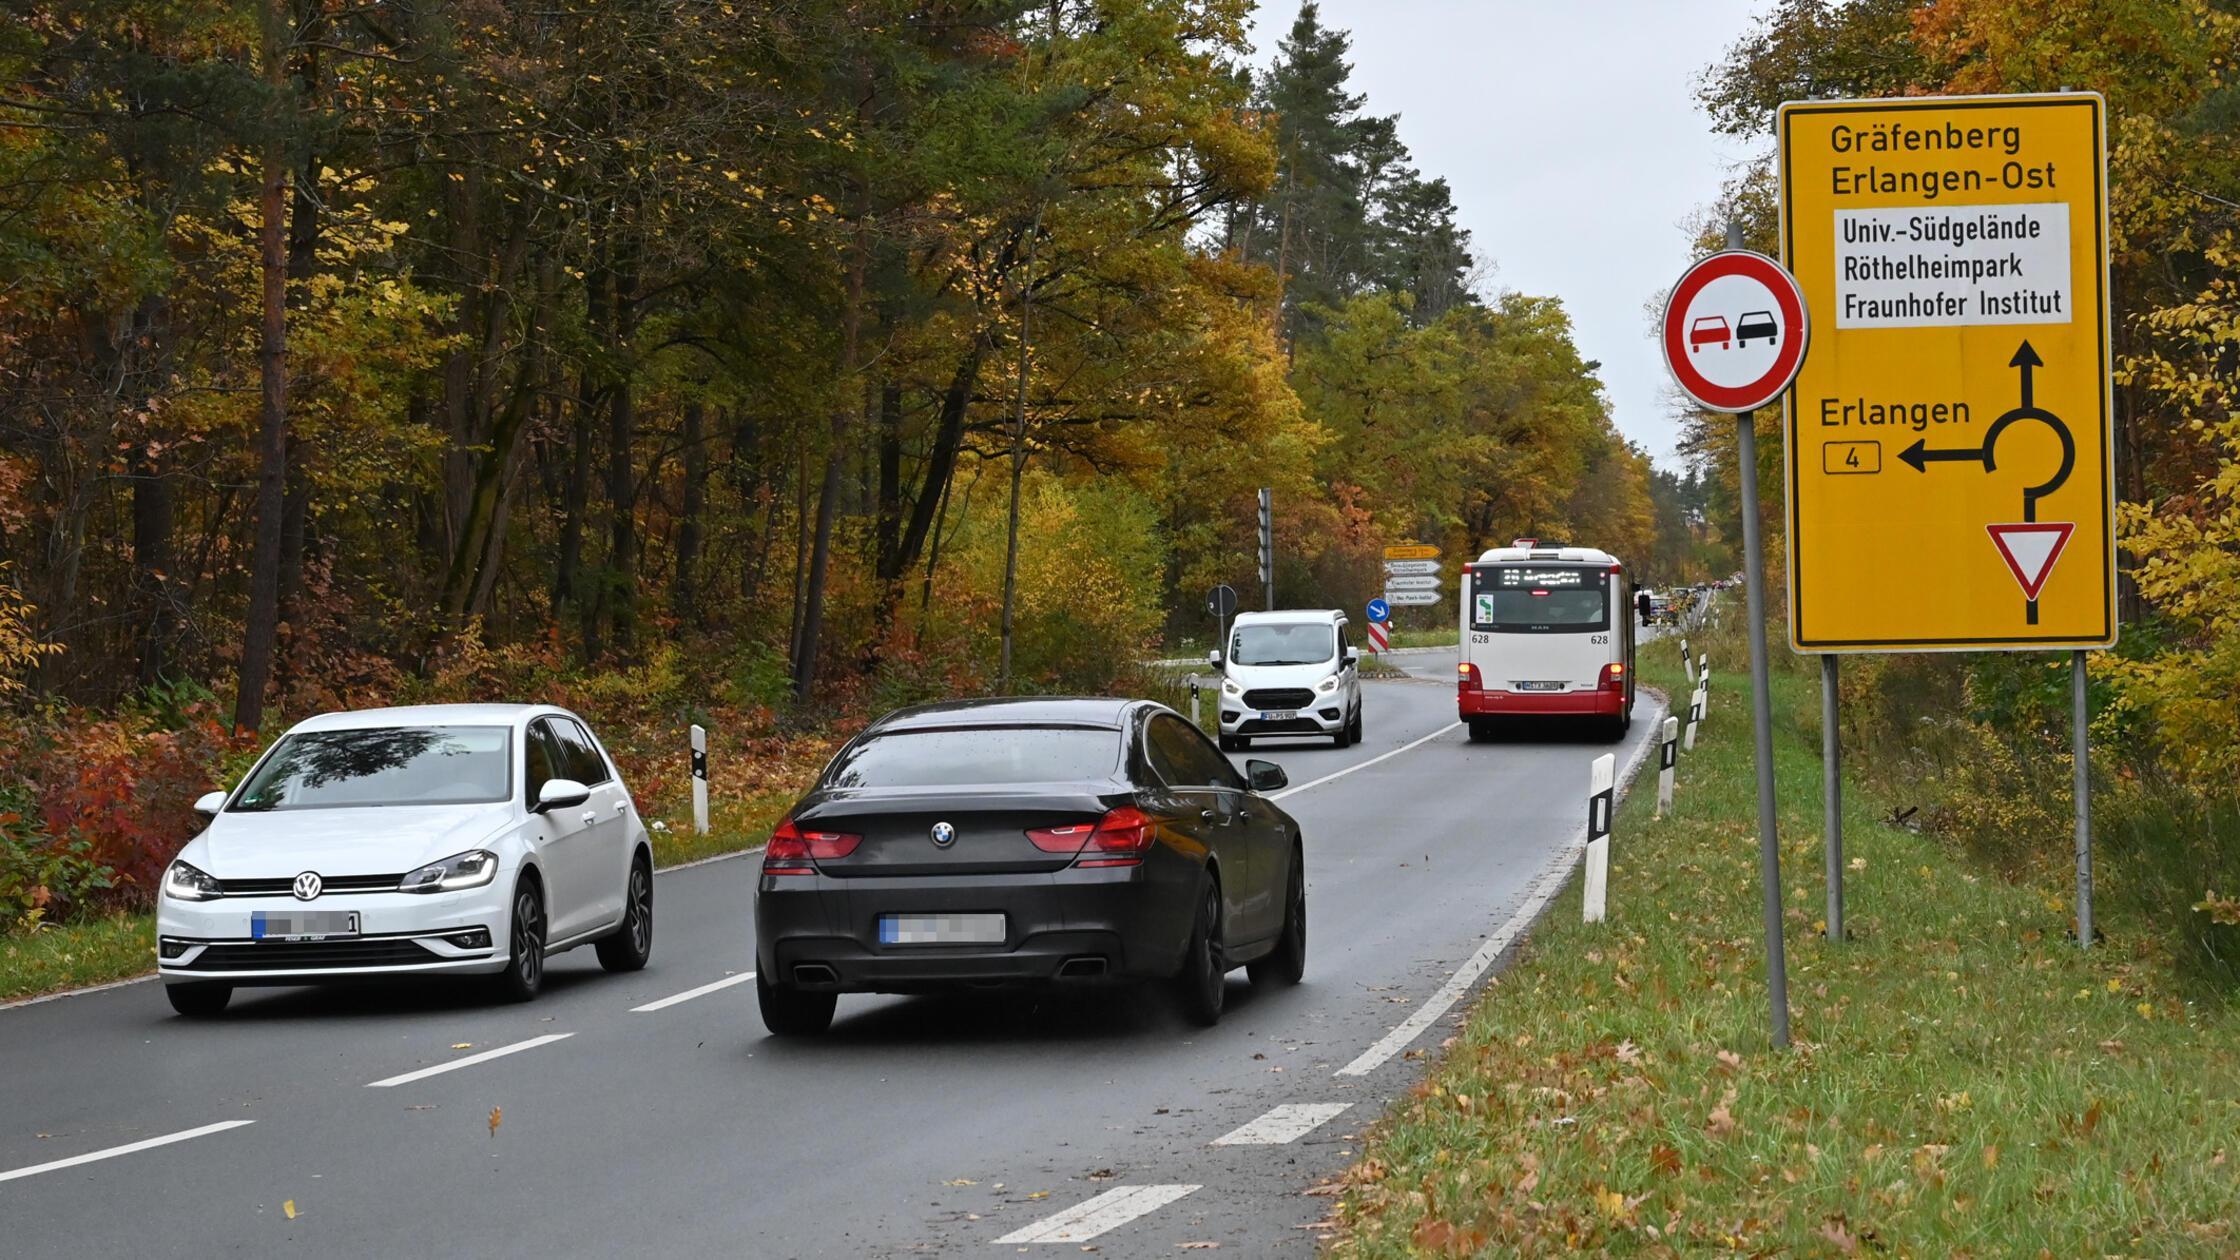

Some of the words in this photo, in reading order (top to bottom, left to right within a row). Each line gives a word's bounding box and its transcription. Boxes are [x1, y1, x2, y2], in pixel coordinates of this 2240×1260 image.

[1831, 122, 2020, 155] Gräfenberg
[1832, 161, 2056, 199] Erlangen-Ost
[1843, 214, 2041, 248] Univ.-Südgelände
[1845, 252, 2023, 285] Röthelheimpark
[1845, 291, 1967, 319] Fraunhofer
[1980, 289, 2062, 316] Institut
[1821, 397, 1970, 432] Erlangen
[1845, 447, 1859, 468] 4
[1471, 634, 1489, 645] 628
[1590, 635, 1609, 645] 628
